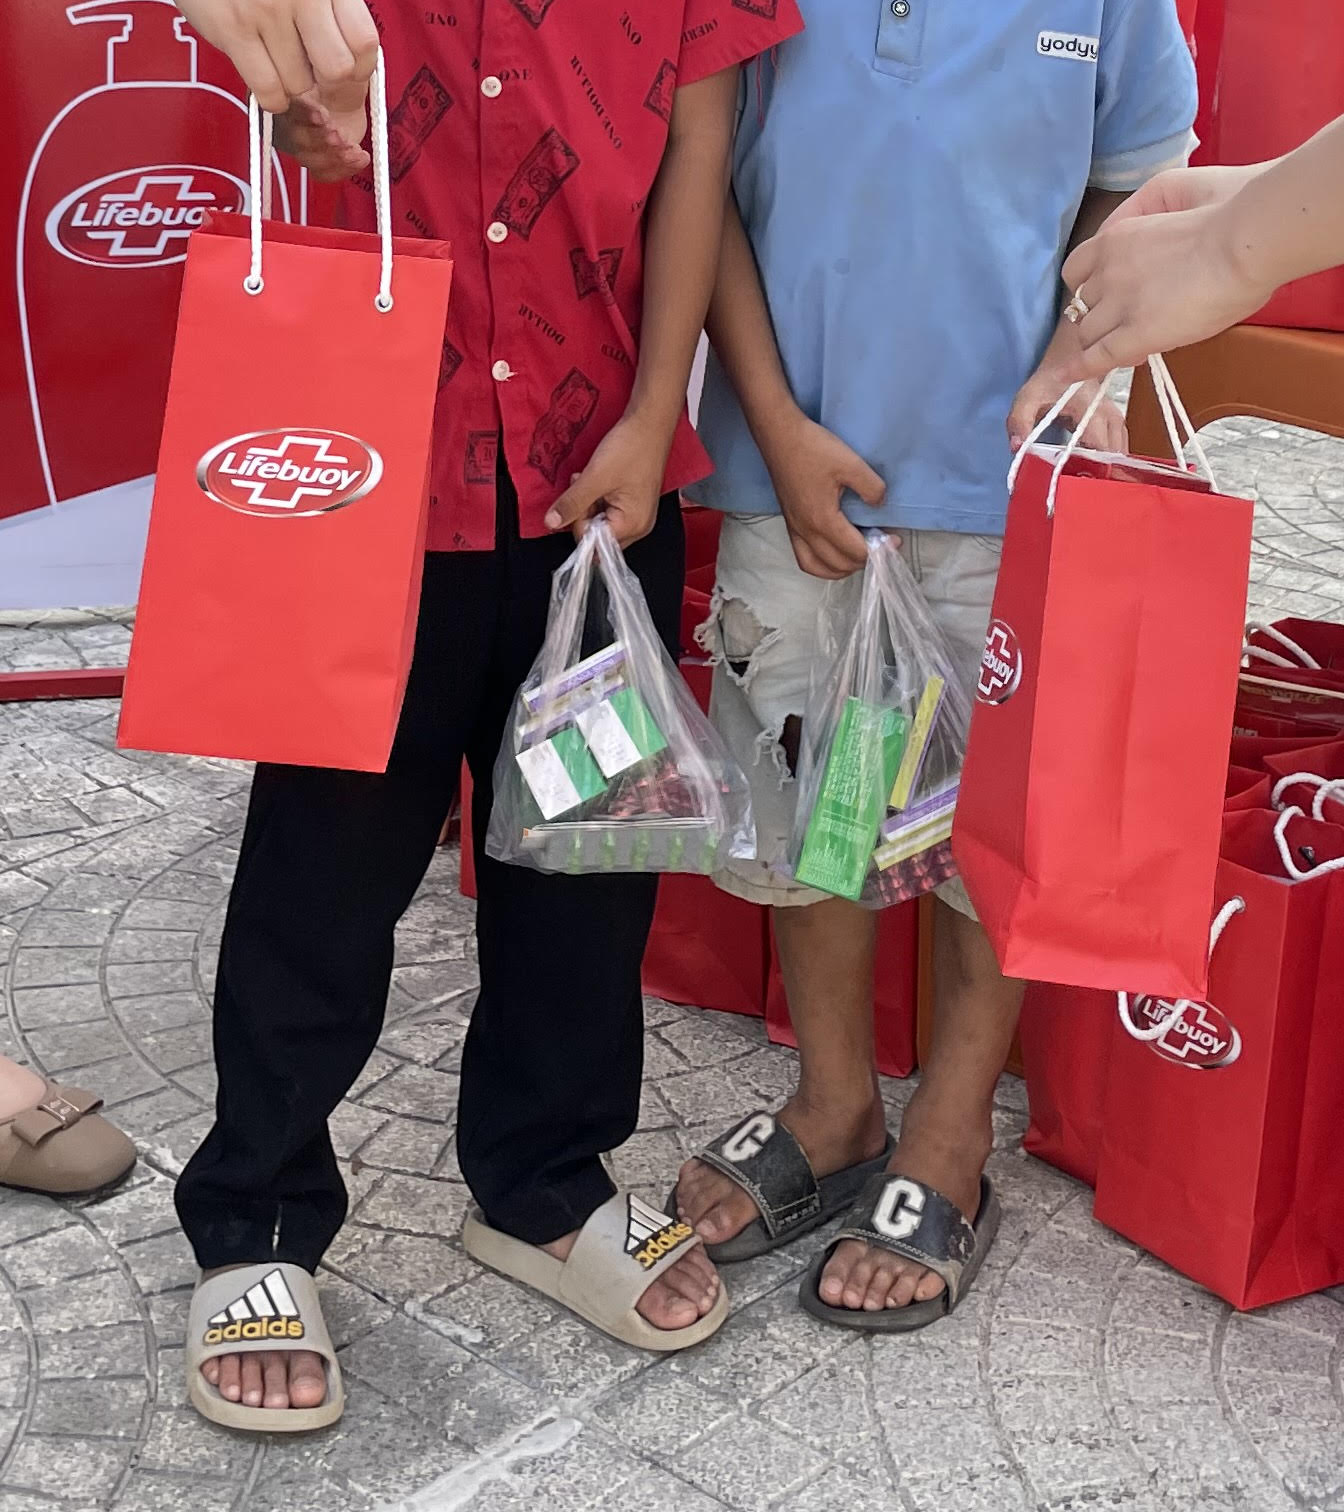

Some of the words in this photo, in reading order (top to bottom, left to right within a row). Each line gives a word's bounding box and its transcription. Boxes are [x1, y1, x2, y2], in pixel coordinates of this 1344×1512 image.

[217, 451, 362, 491] Lifebuoy
[721, 1112, 777, 1163] G
[870, 1178, 927, 1239] G
